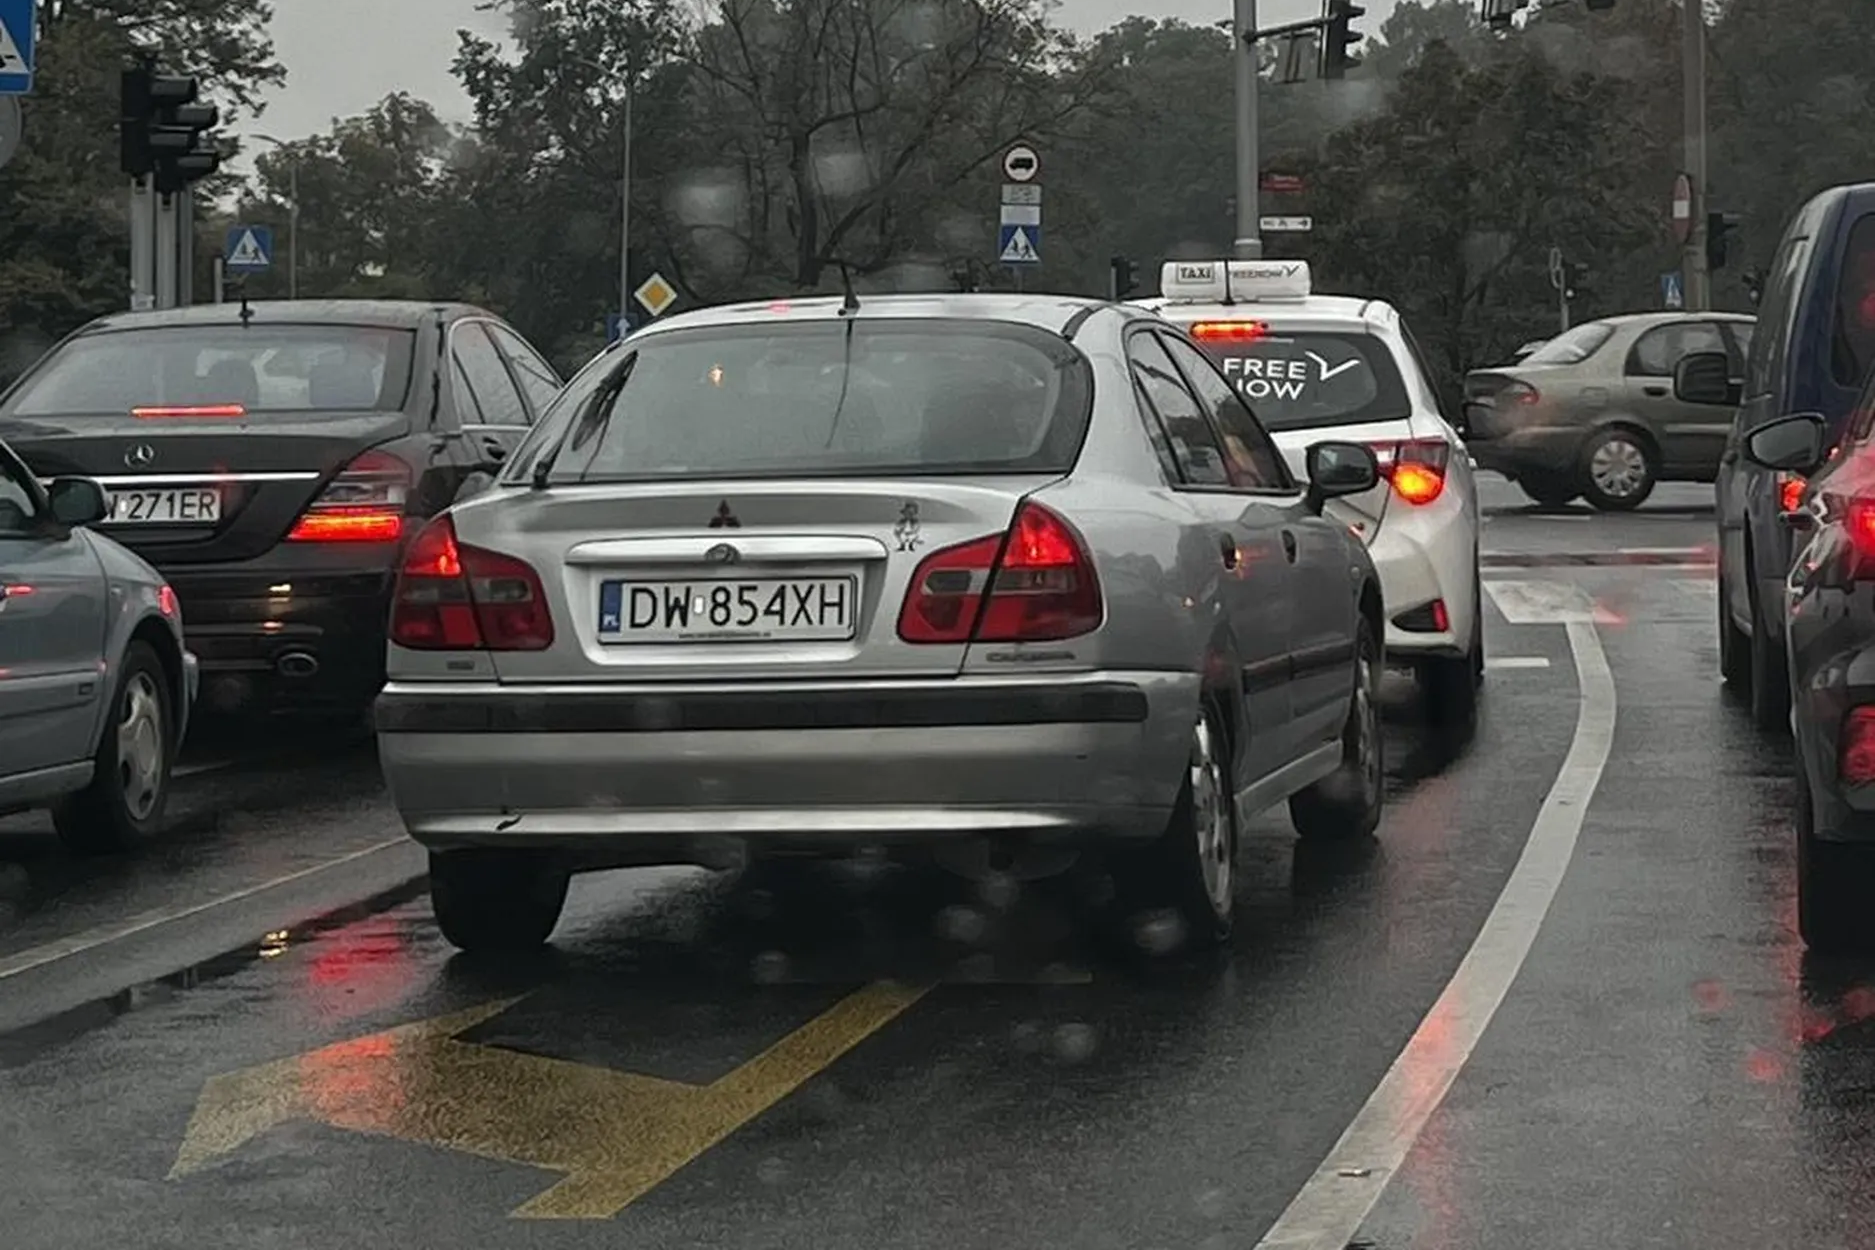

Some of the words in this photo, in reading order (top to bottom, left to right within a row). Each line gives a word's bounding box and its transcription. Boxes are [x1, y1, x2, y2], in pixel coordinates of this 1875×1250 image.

[1180, 263, 1211, 279] TAXI
[1223, 358, 1307, 380] FREE
[128, 492, 215, 519] 271ER
[629, 586, 691, 628] DW
[709, 584, 844, 626] 854XH
